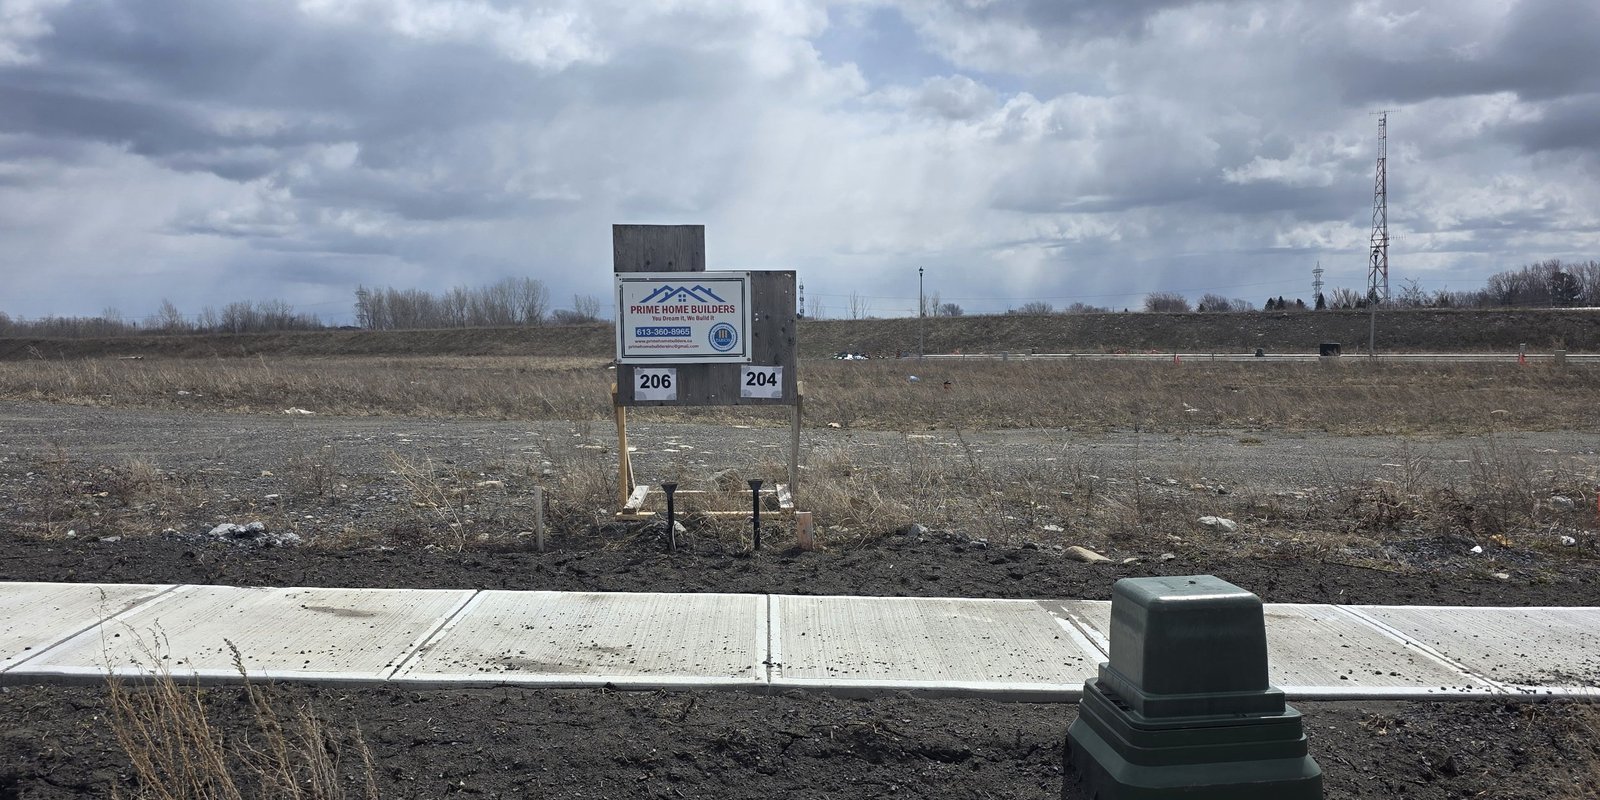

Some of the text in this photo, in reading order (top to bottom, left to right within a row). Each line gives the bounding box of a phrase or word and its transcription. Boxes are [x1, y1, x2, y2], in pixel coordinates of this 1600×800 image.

[630, 304, 735, 314] PRIME HOME BUILDERS
[636, 328, 690, 336] 613-360-8965
[640, 374, 671, 389] 206
[746, 372, 777, 387] 204
